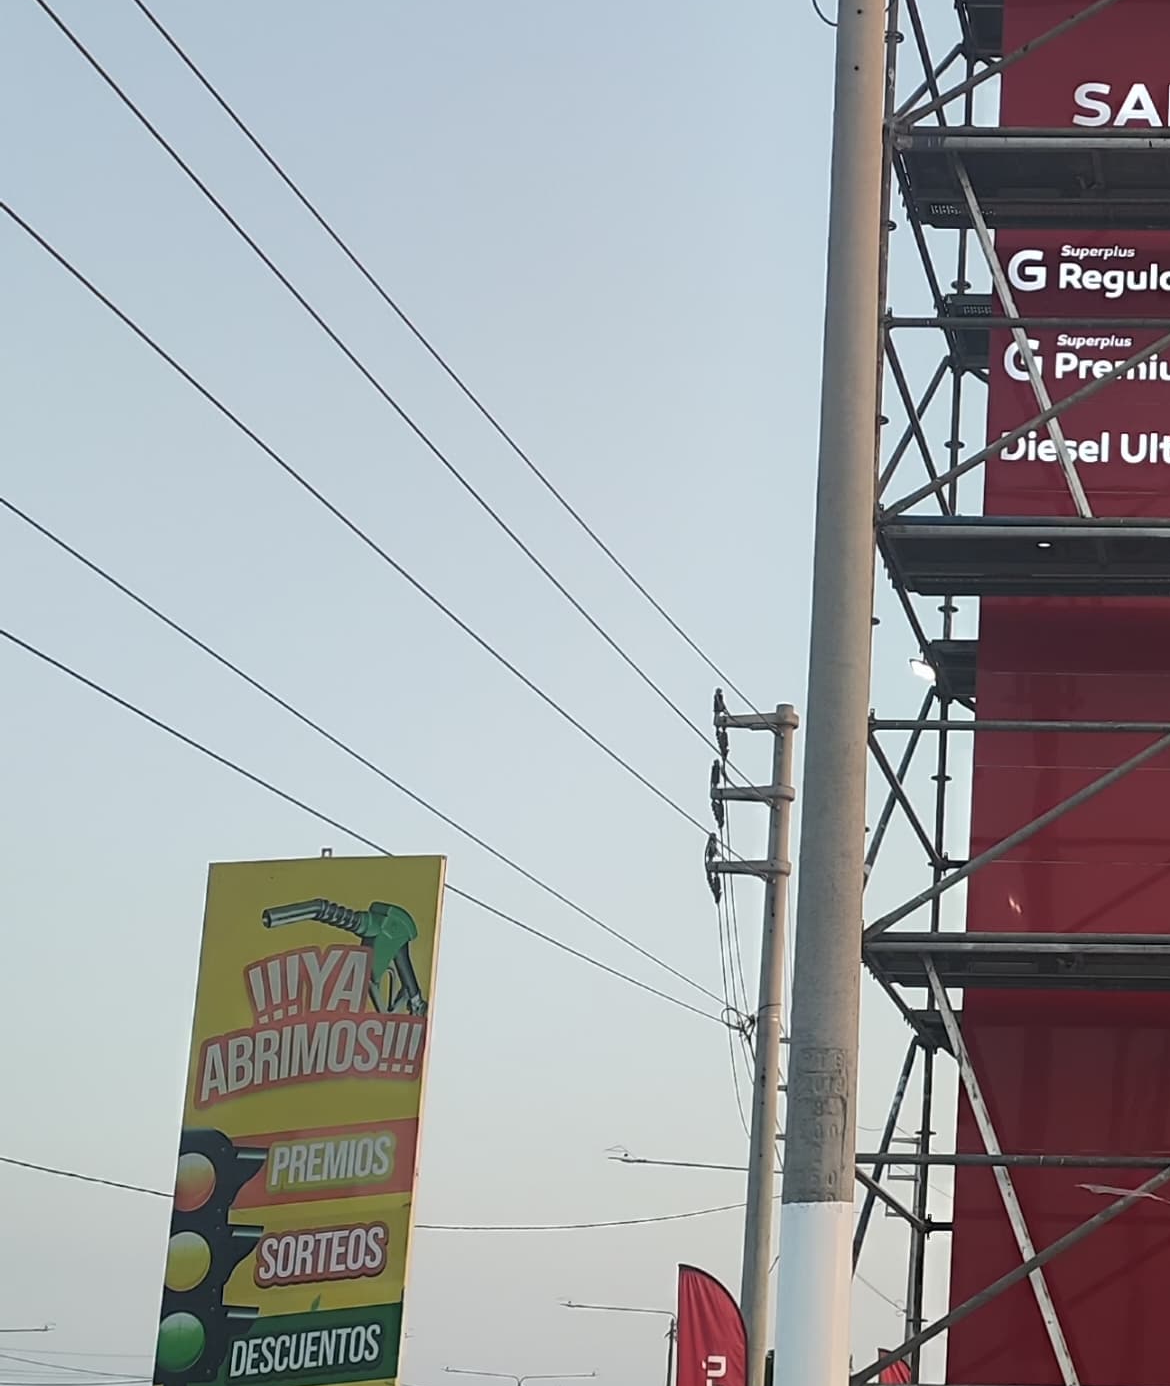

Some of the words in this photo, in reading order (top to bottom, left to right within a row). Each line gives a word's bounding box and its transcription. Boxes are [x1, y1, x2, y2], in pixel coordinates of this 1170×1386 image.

[1060, 244, 1136, 262] Superplus
[1056, 334, 1133, 350] Superplus
[200, 1019, 424, 1102] ABRIMOS!!!
[270, 1135, 393, 1186] PREMIOS
[258, 1225, 385, 1280] SORTEOS
[229, 1324, 382, 1378] DESCUENTOS
